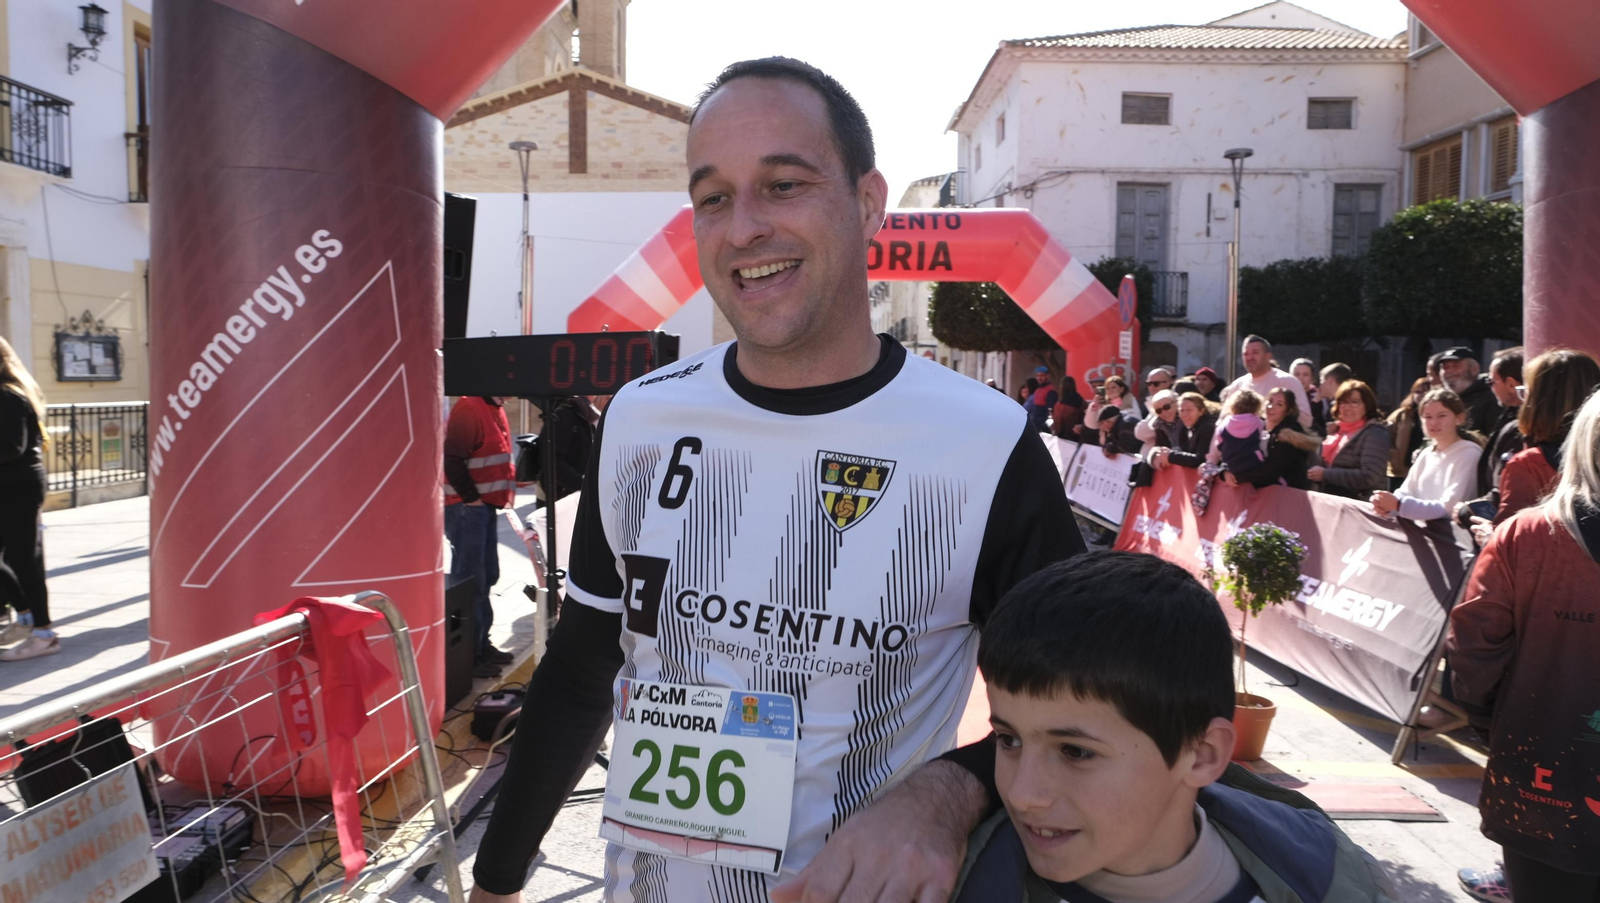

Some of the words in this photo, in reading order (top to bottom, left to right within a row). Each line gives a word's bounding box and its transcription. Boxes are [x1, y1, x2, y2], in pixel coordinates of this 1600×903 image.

[658, 436, 702, 509] 6
[825, 452, 872, 466] CANTORIA
[841, 486, 860, 495] 2017
[675, 589, 908, 652] COSENTINO
[1553, 610, 1595, 623] VALLE
[697, 632, 761, 661] imagine
[779, 651, 873, 677] anticipate
[649, 685, 686, 706] CxM
[691, 698, 723, 708] Cantoria
[641, 706, 717, 733] PÓLVORA
[629, 739, 746, 816] 256
[1519, 790, 1572, 808] COSENTINO
[6, 794, 95, 861] ALYSER
[624, 810, 654, 823] GRANERO
[718, 826, 747, 838] MIGUEL
[2, 812, 148, 903] MAQUINARIA
